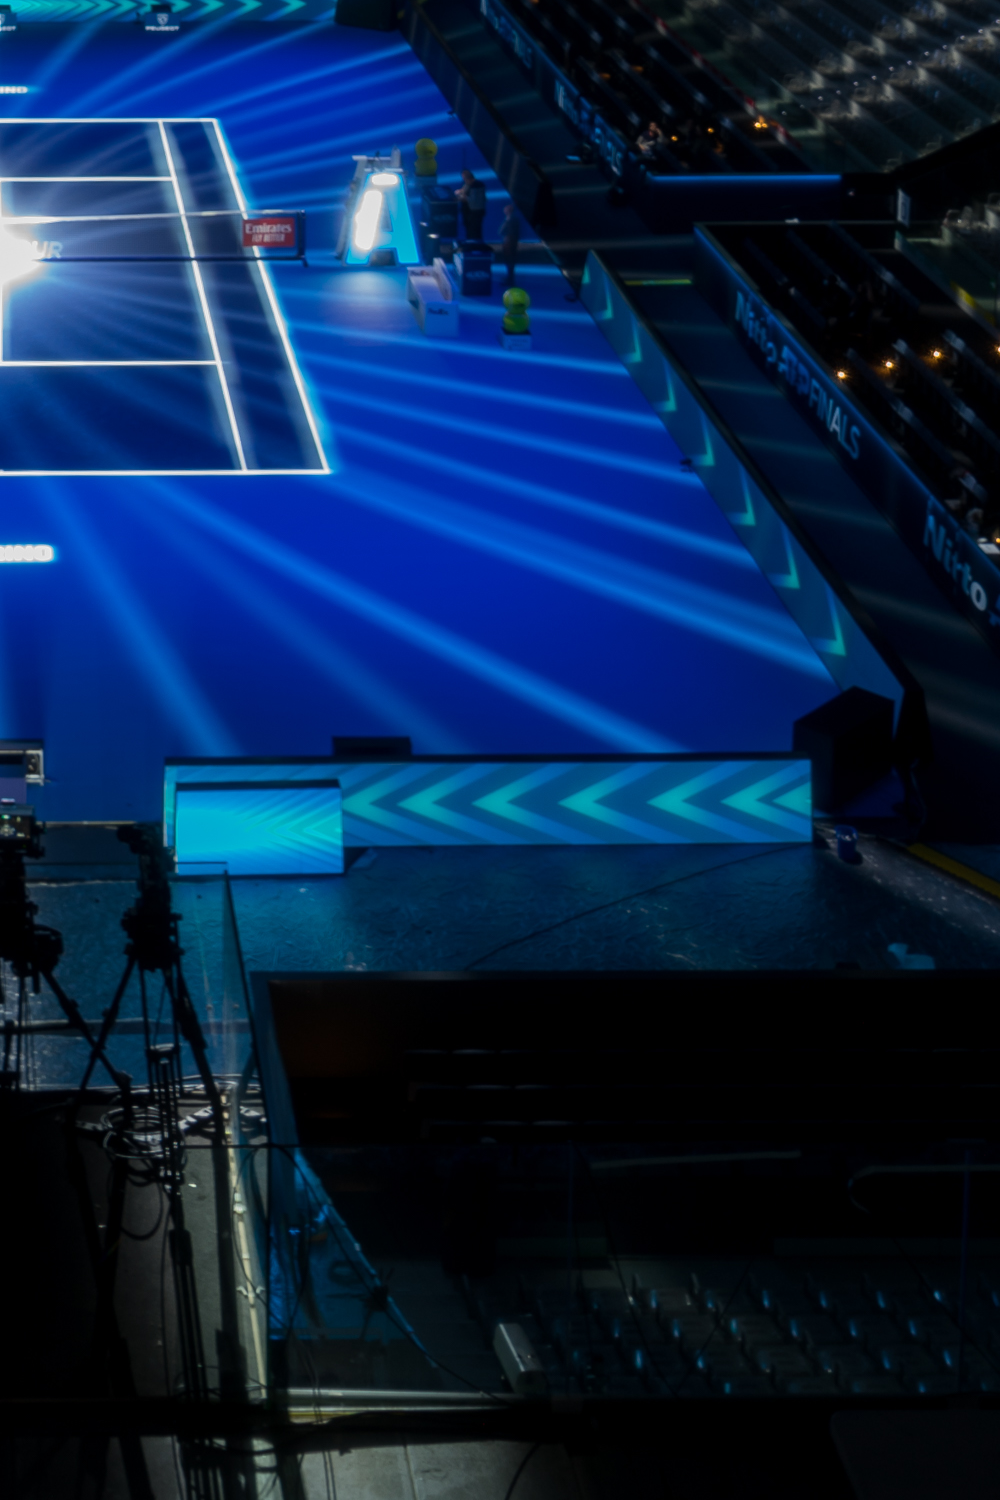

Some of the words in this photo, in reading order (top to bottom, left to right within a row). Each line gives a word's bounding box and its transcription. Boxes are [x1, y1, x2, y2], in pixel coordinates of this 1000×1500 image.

[245, 223, 292, 234] Emirates
[808, 378, 861, 460] FINALS
[922, 513, 988, 612] Nitto
